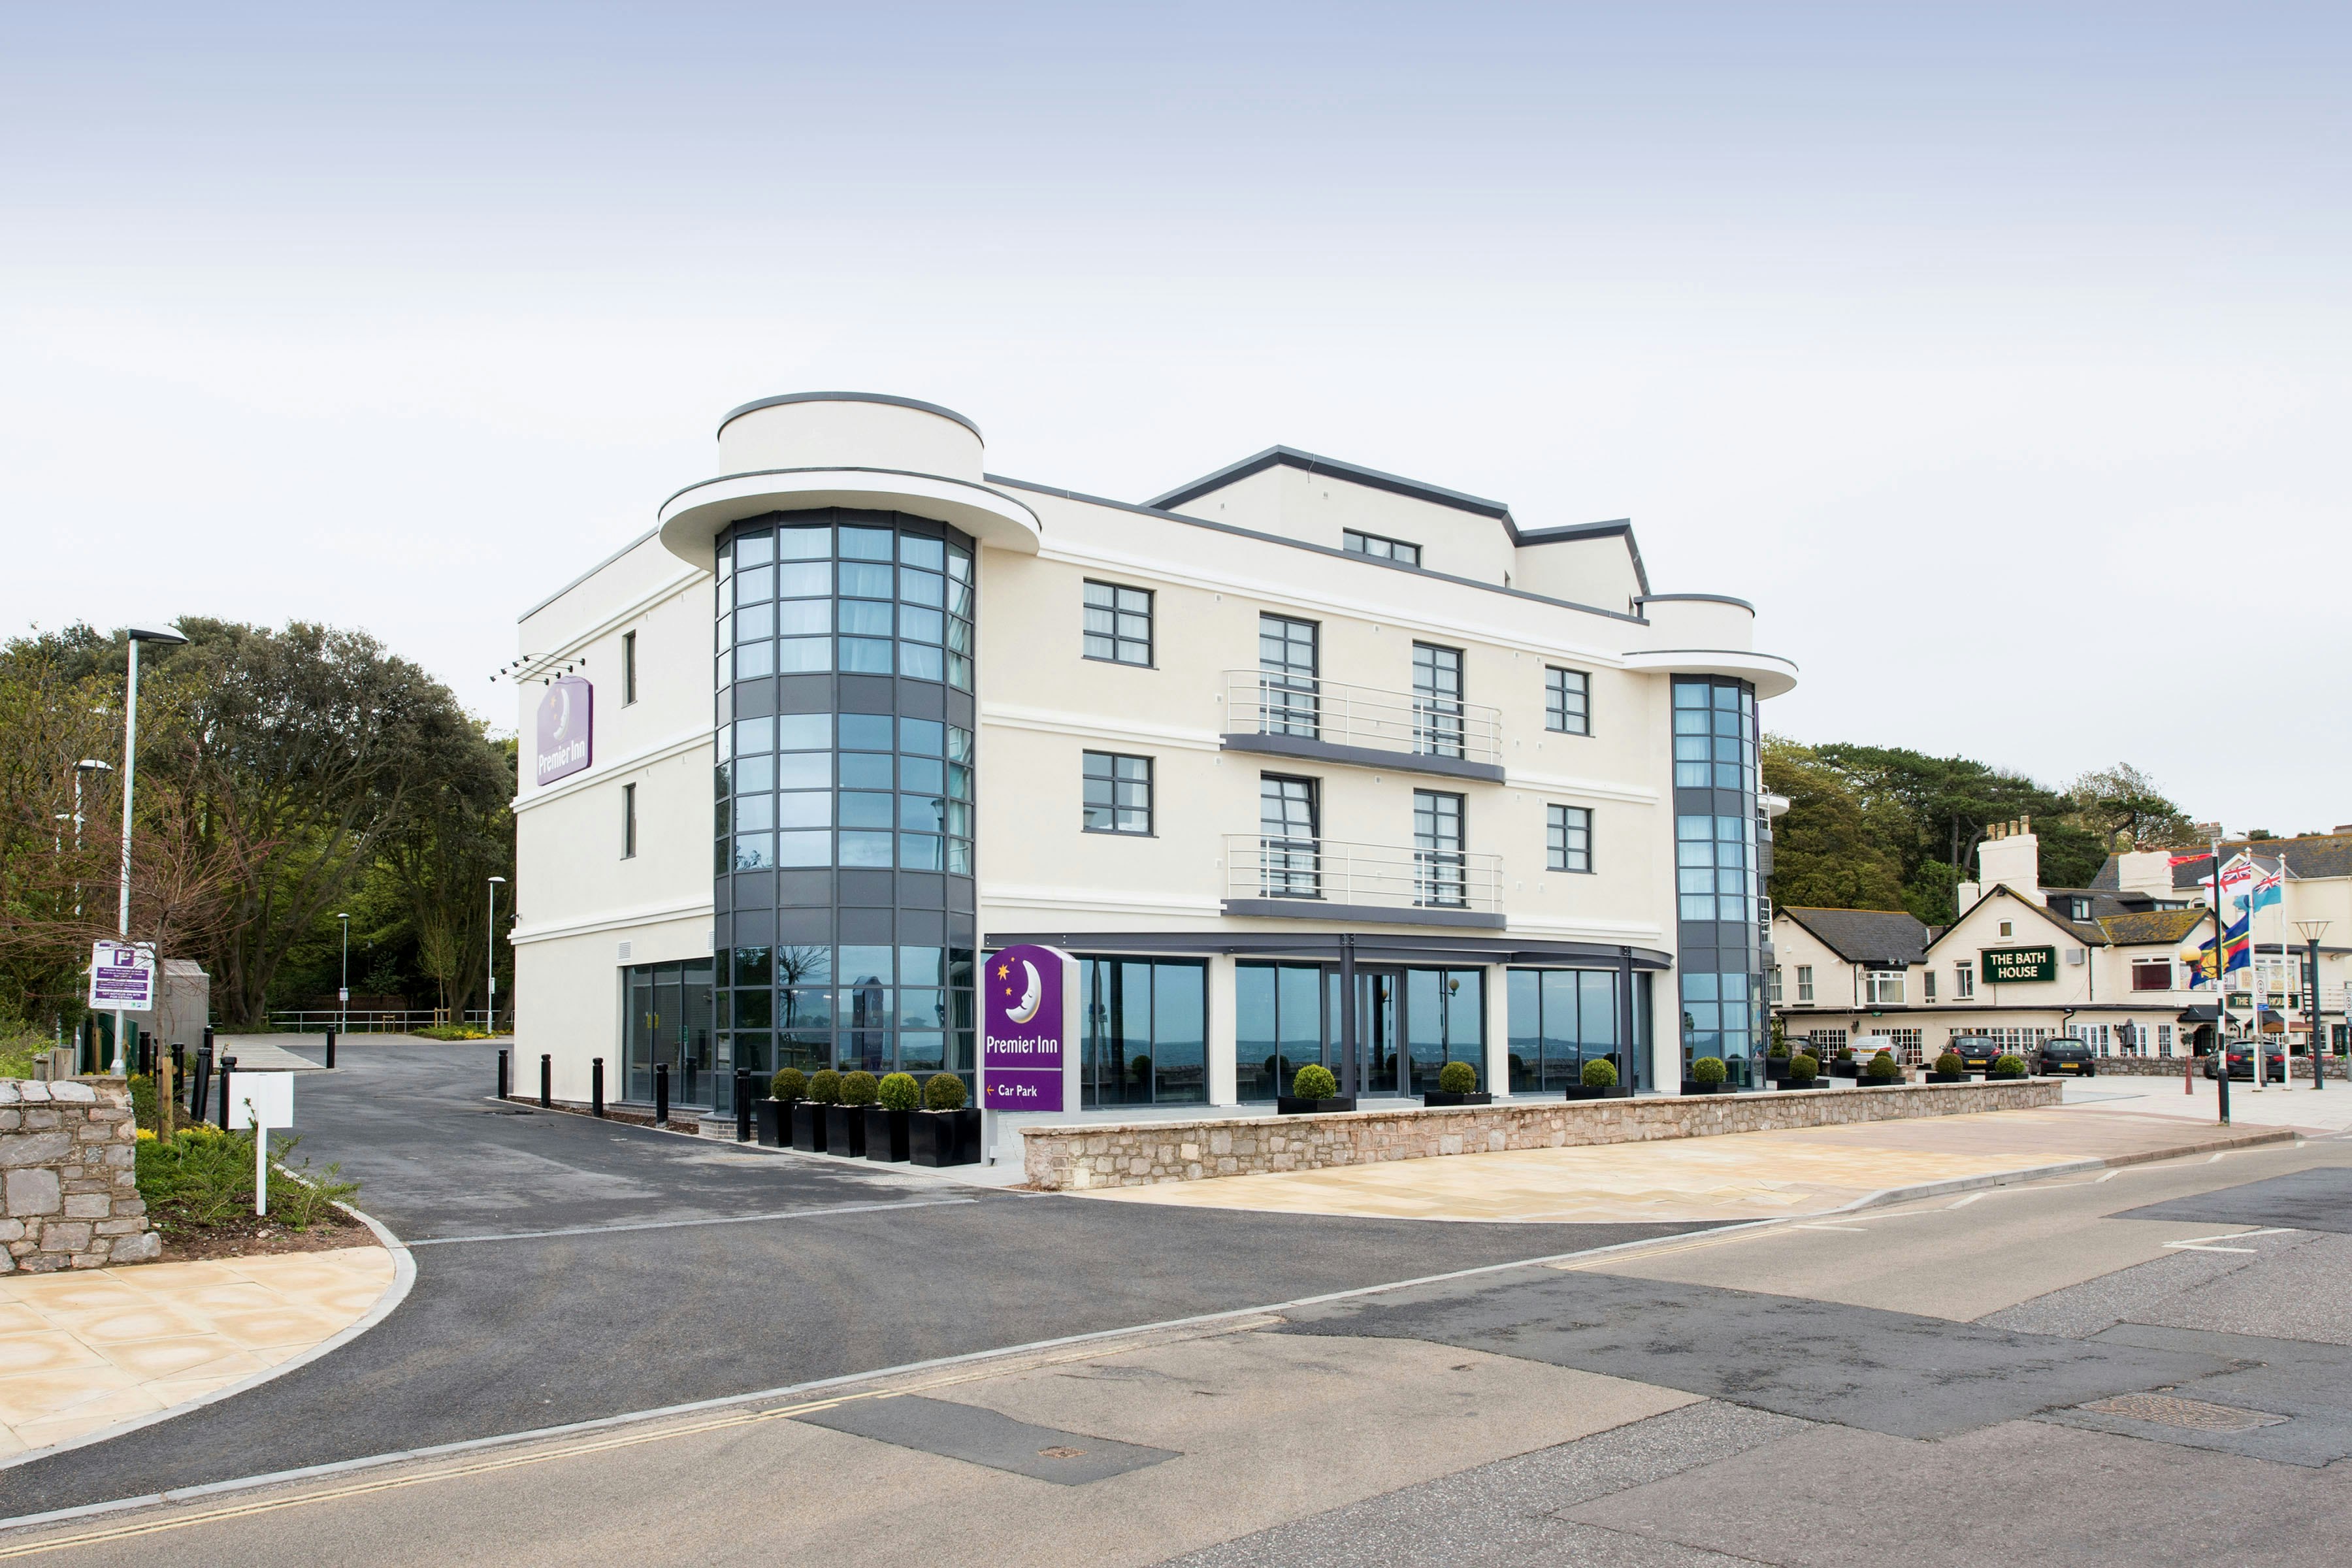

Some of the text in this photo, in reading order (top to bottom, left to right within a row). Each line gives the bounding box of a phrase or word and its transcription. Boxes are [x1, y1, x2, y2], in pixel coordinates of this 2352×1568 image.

[538, 740, 585, 776] Premier Inn
[1990, 952, 2046, 965] THE BATH
[1998, 966, 2038, 978] HOUSE
[2234, 997, 2249, 1006] THE
[987, 1035, 1058, 1054] Premier Inn
[998, 1085, 1037, 1097] Car Park
